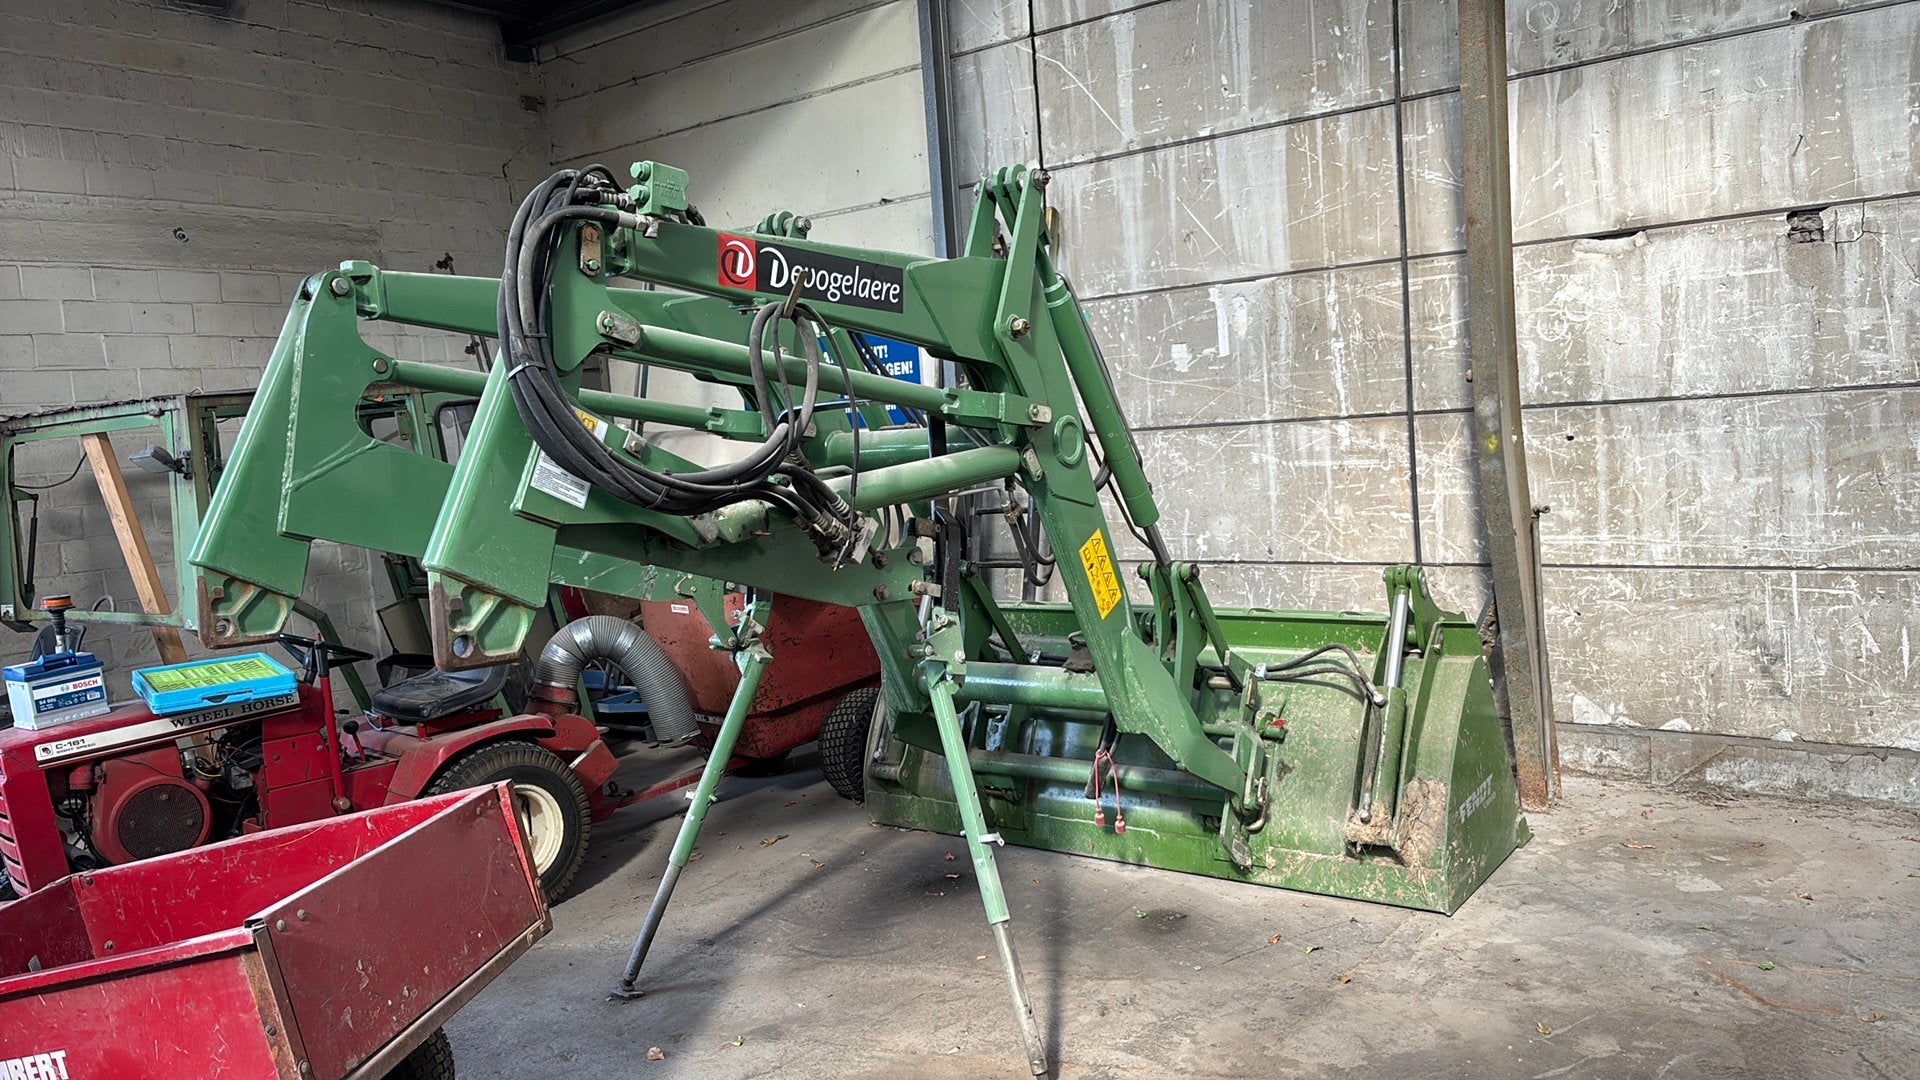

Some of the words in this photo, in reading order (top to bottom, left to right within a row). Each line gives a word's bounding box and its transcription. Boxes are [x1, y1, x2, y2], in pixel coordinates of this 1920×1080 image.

[760, 247, 900, 303] Devogelaere
[72, 680, 98, 690] BOSCH
[170, 708, 234, 728] WHEEL
[241, 694, 294, 713] HORSE
[55, 739, 85, 750] C-161
[0, 1049, 69, 1080] BERT
